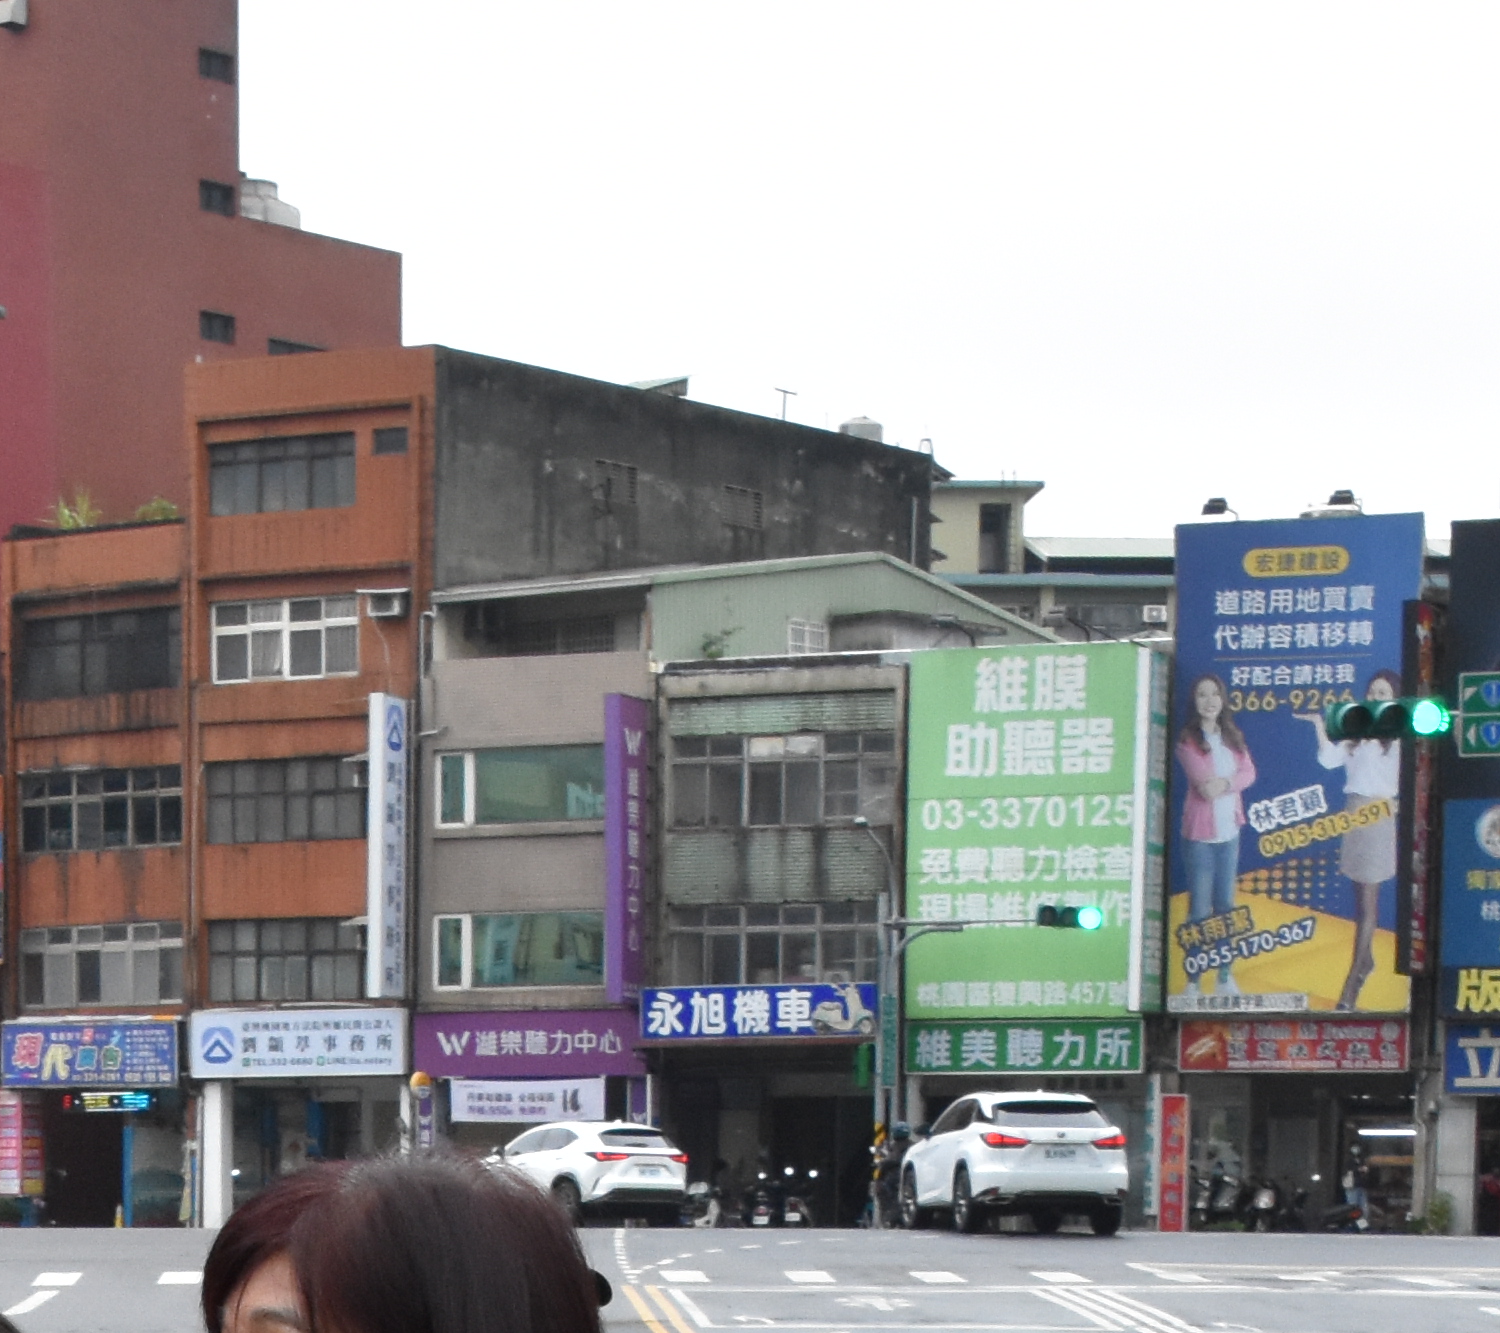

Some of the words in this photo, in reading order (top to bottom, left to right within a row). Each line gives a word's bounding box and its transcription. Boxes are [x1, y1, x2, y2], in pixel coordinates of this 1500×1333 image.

[1215, 585, 1375, 616] 道路用地買賣
[1214, 621, 1374, 651] 代辦容積移轉
[1231, 663, 1356, 687] 好配合請找我
[945, 717, 1115, 778] 助聽器
[921, 795, 1134, 831] 03-3370125
[1259, 801, 1393, 856] 0915-313-591
[919, 846, 1133, 884] 免費聽力檢查
[1184, 919, 1316, 975] 0955-170-367
[646, 990, 812, 1036] 永旭機車
[915, 1027, 1131, 1069] 維美聽力所
